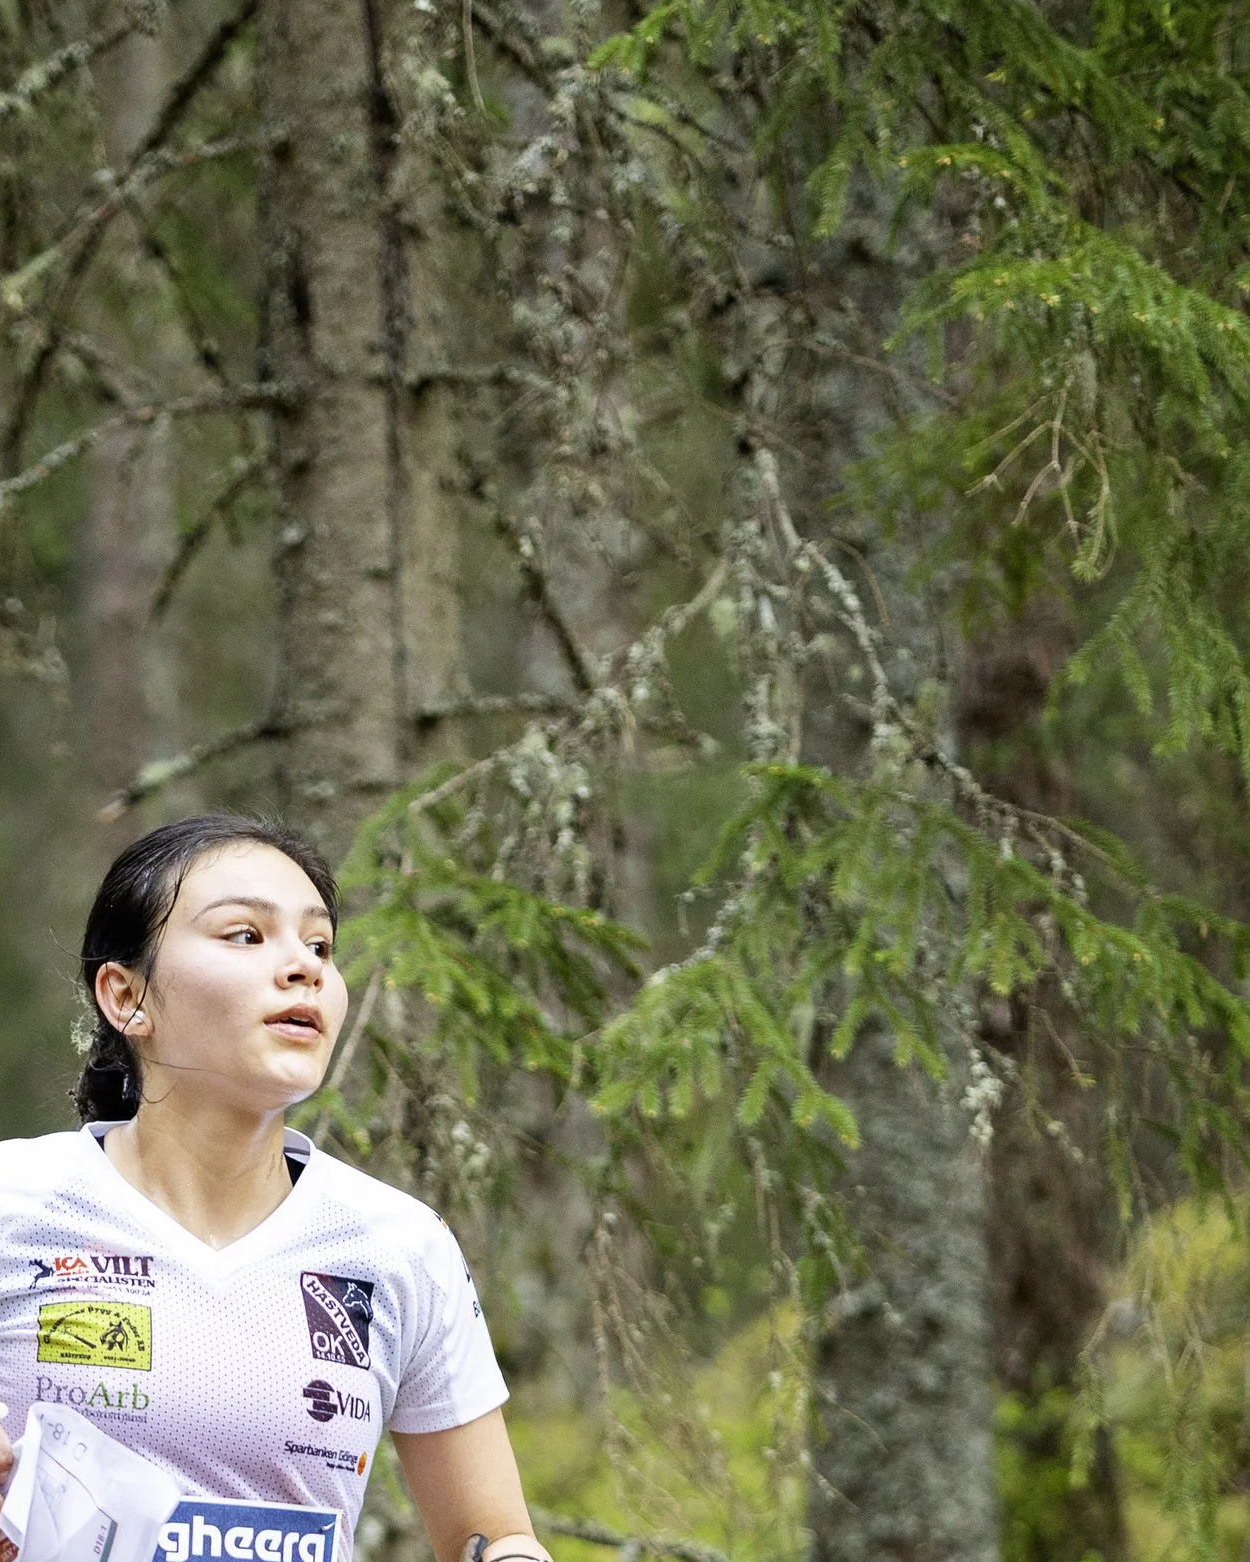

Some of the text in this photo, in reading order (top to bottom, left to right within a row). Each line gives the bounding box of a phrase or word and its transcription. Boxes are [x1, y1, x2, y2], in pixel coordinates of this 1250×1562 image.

[54, 1254, 154, 1278] ICA VILT
[313, 1331, 346, 1356] OK
[35, 1376, 150, 1411] ProArb
[337, 1391, 371, 1423] VIDA
[284, 1440, 338, 1460] Sparbanken
